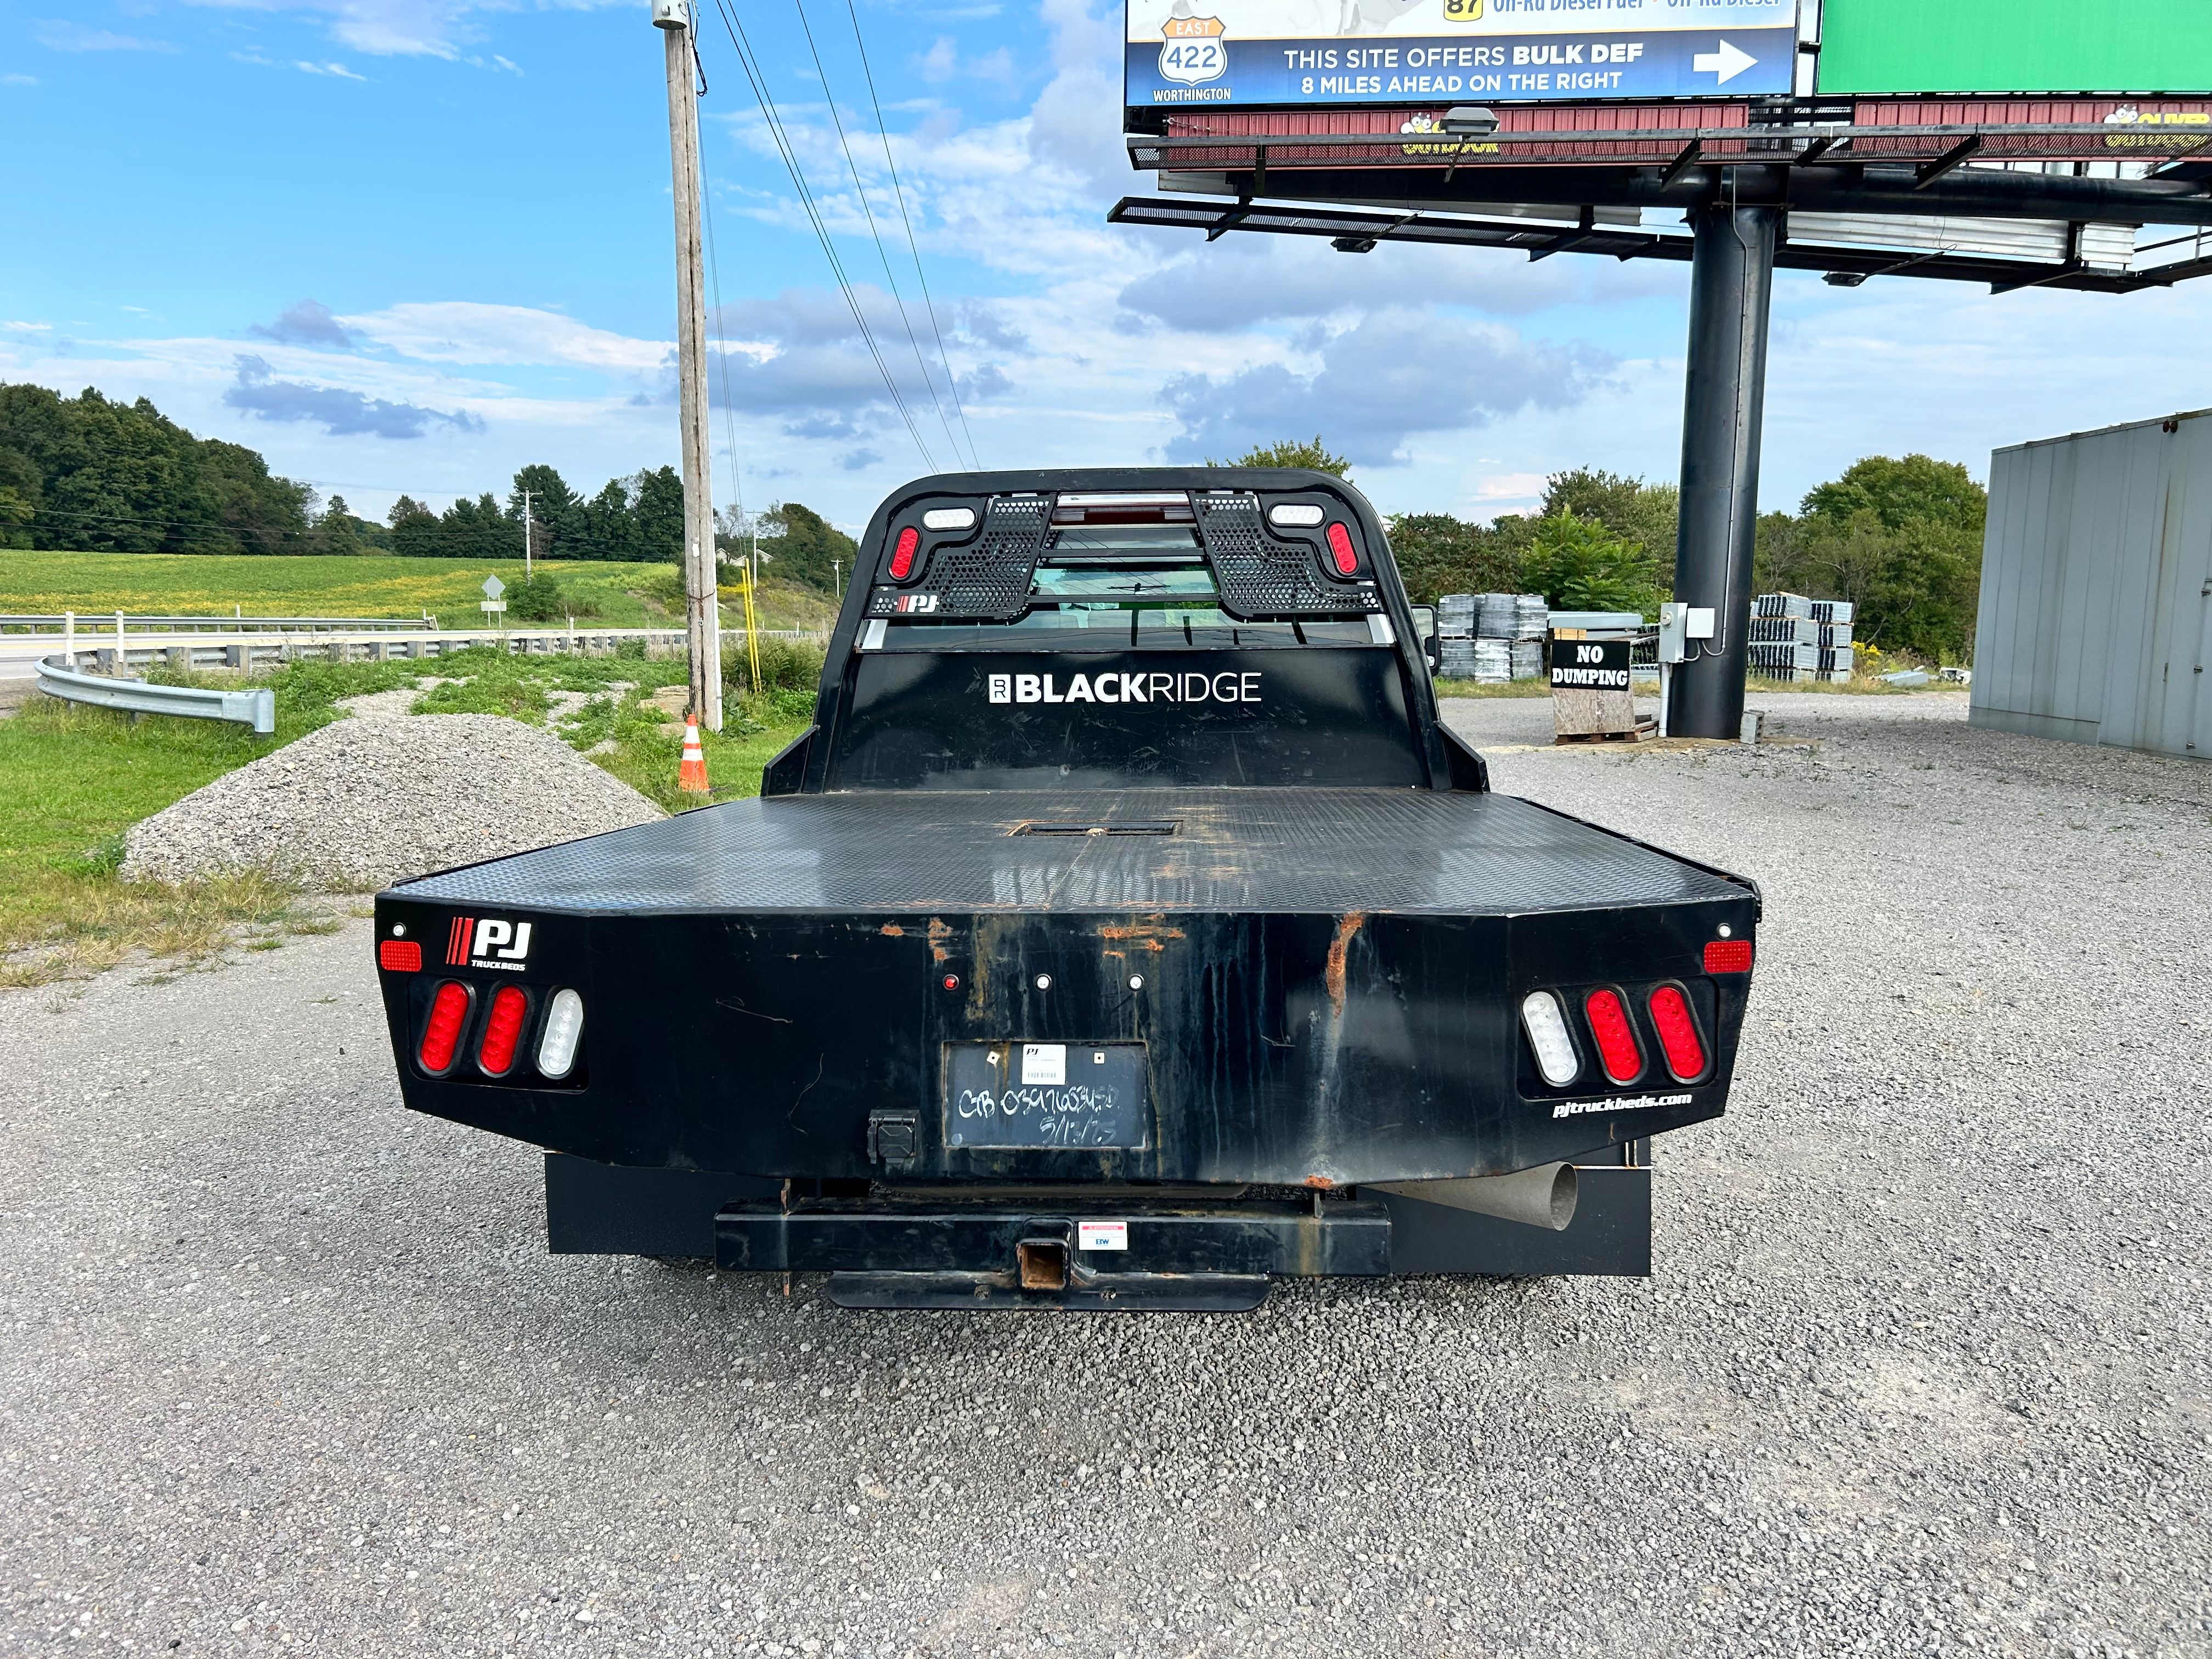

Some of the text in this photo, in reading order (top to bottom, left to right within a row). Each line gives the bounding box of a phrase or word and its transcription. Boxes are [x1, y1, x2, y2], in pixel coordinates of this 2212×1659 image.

[1176, 22, 1210, 36] EAST
[1167, 46, 1216, 69] 422
[1284, 43, 1644, 69] THIS SITE OFFERS BULK DEF
[1301, 72, 1623, 94] 8 MILES AHEAD ON THE RIGHT
[1153, 88, 1231, 103] WORTHINGTON
[907, 595, 938, 613] PJ
[1577, 645, 1604, 663] NO
[1016, 672, 1262, 703] BLACKRIDGE
[1551, 668, 1628, 686] DUMPING
[472, 919, 532, 960] PJ
[1552, 1094, 1692, 1119] pjtruckbeds.com
